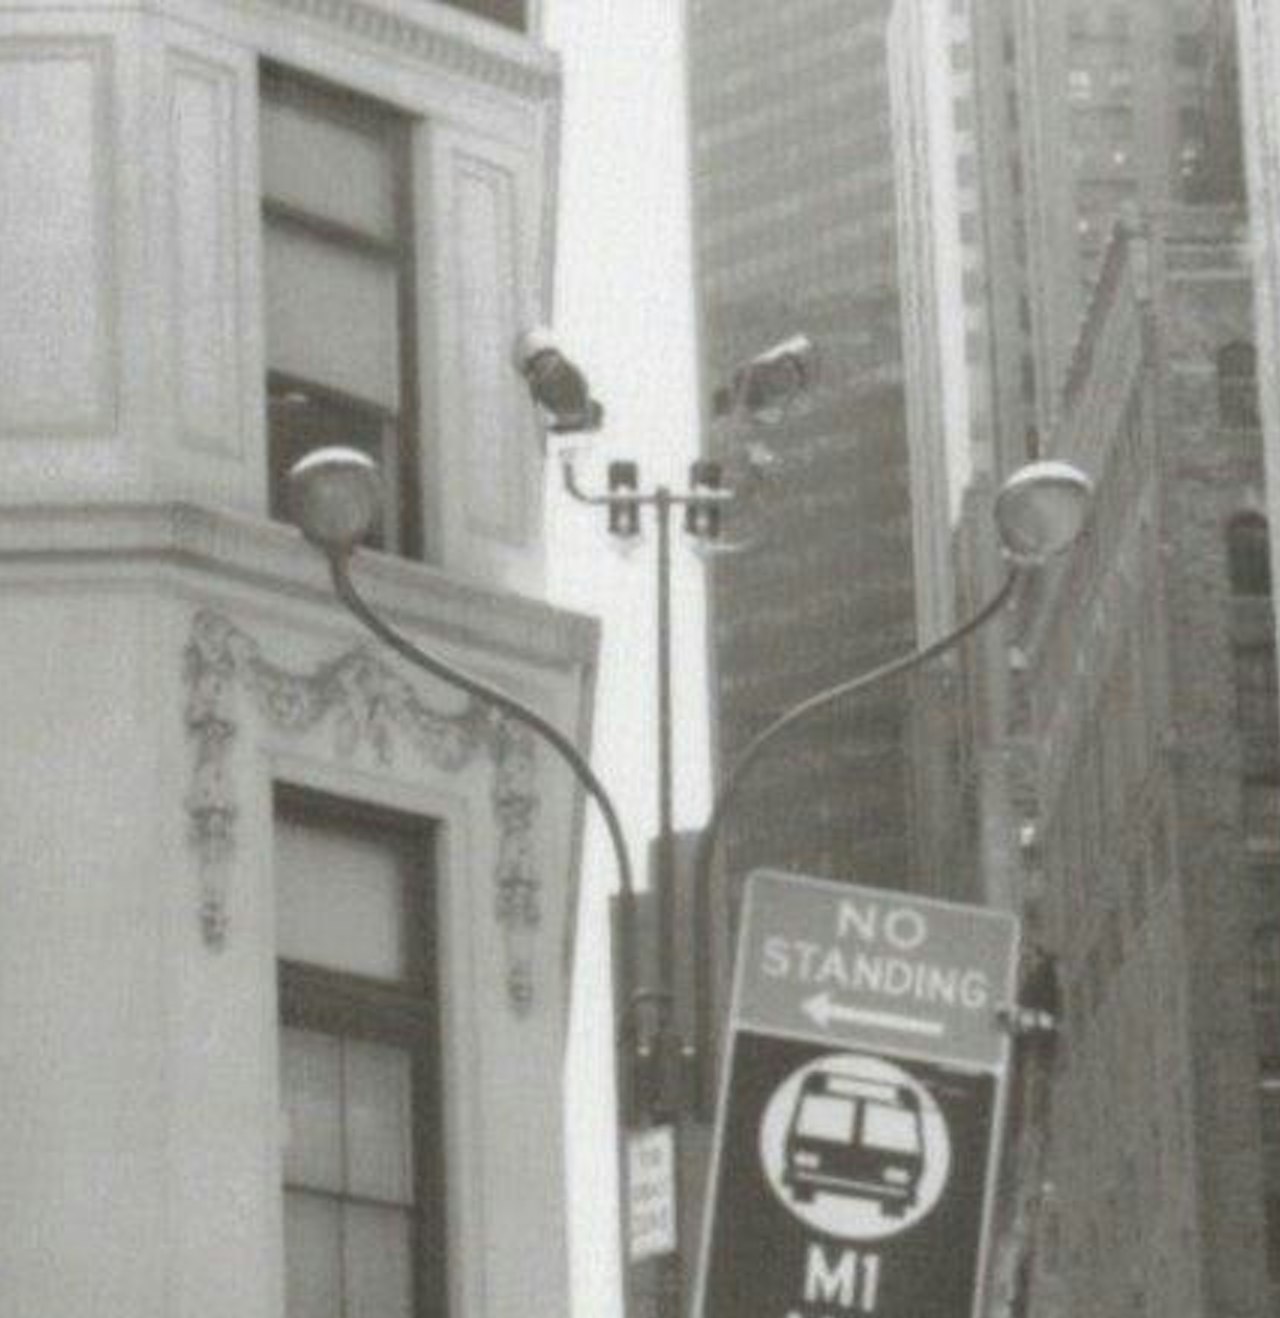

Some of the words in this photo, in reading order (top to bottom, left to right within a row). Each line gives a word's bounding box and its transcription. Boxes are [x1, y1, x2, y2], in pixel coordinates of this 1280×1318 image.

[837, 903, 927, 949] NO
[761, 937, 988, 1007] STANDING
[805, 1244, 882, 1313] M1
